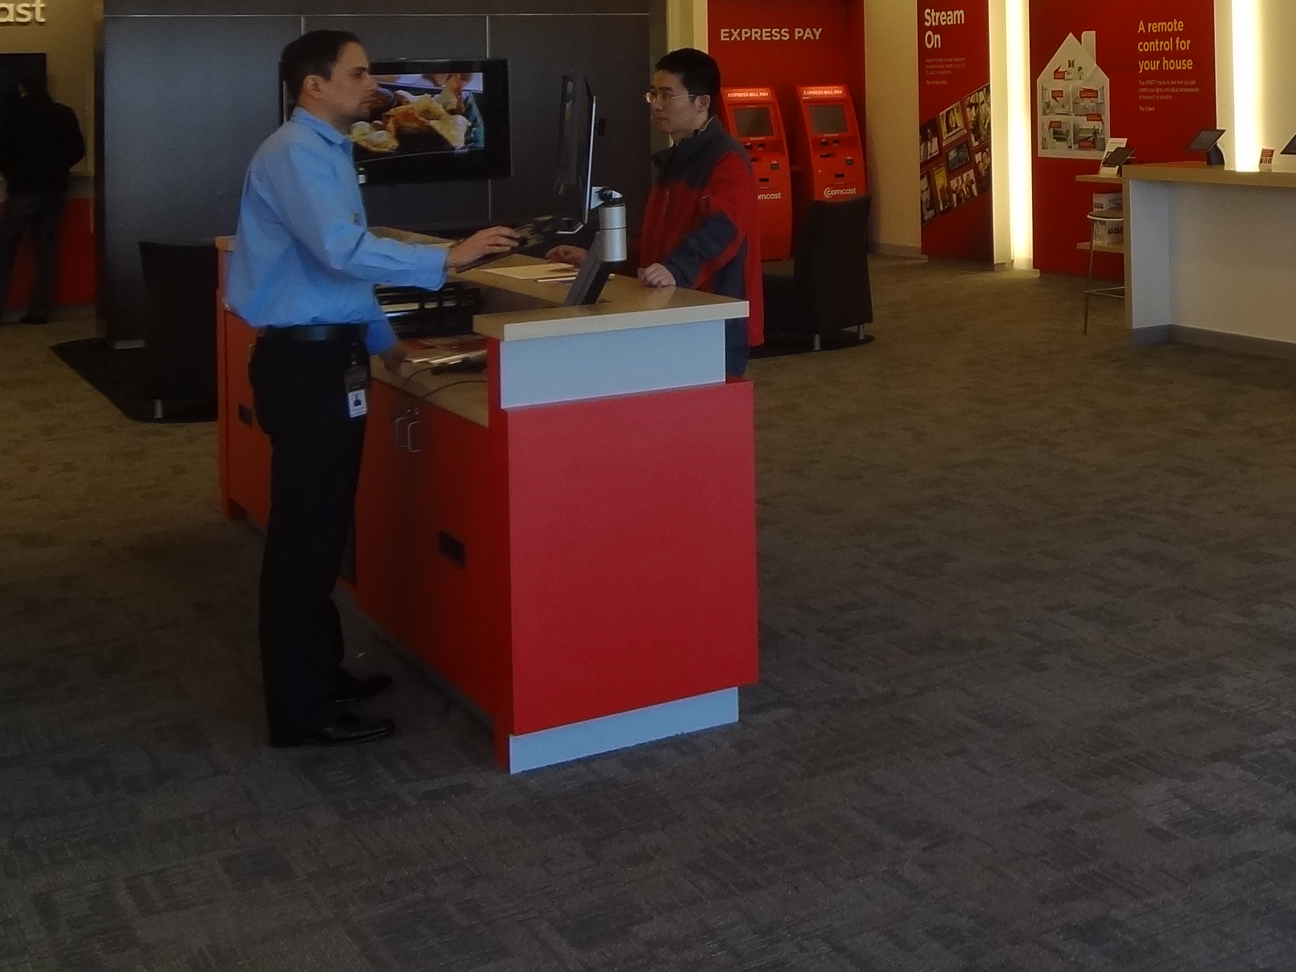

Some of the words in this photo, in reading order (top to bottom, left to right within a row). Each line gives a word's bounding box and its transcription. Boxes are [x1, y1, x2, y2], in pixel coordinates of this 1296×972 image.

[924, 8, 965, 27] Stream
[1137, 20, 1146, 33] A
[1147, 18, 1184, 33] remote
[720, 28, 790, 41] EXPRESS
[794, 27, 823, 41] PAY
[924, 30, 941, 49] On
[1137, 37, 1173, 52] control
[1175, 36, 1191, 51] for
[1138, 60, 1161, 74] your
[1162, 56, 1193, 70] house
